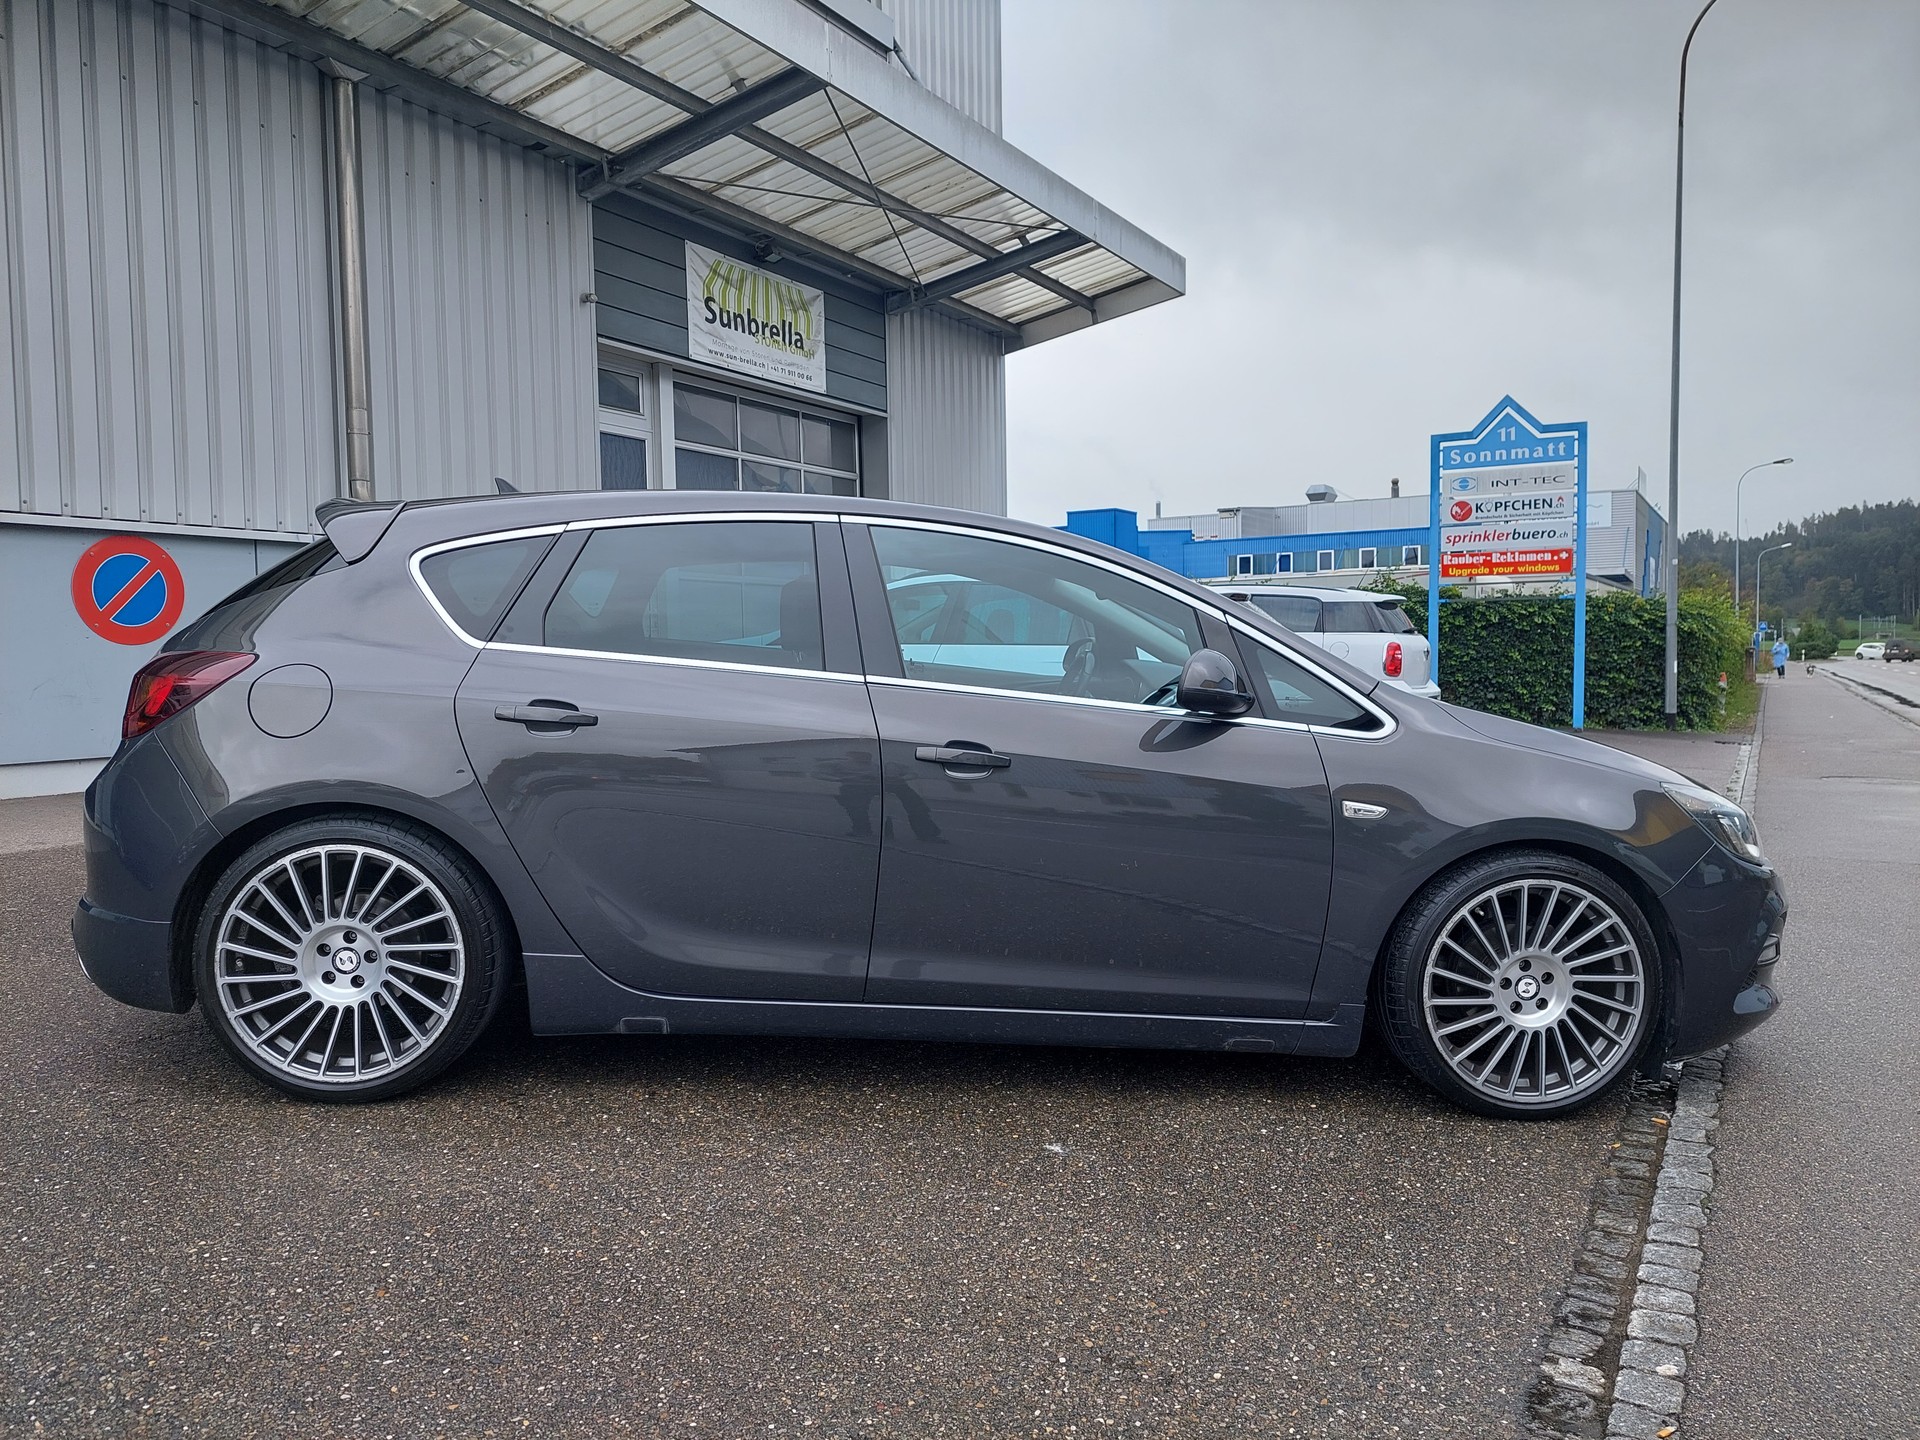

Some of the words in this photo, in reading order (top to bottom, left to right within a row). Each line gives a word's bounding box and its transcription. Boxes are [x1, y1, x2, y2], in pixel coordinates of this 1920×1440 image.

[704, 296, 804, 351] Sunbrella
[1497, 426, 1516, 442] 11
[1450, 441, 1567, 465] Sonnmatt
[1491, 475, 1567, 488] INT-TEC
[1445, 527, 1569, 547] sprinklerbuero.ch
[1449, 565, 1489, 577] Upgrade
[1493, 565, 1515, 574] your
[1521, 563, 1560, 573] windows
